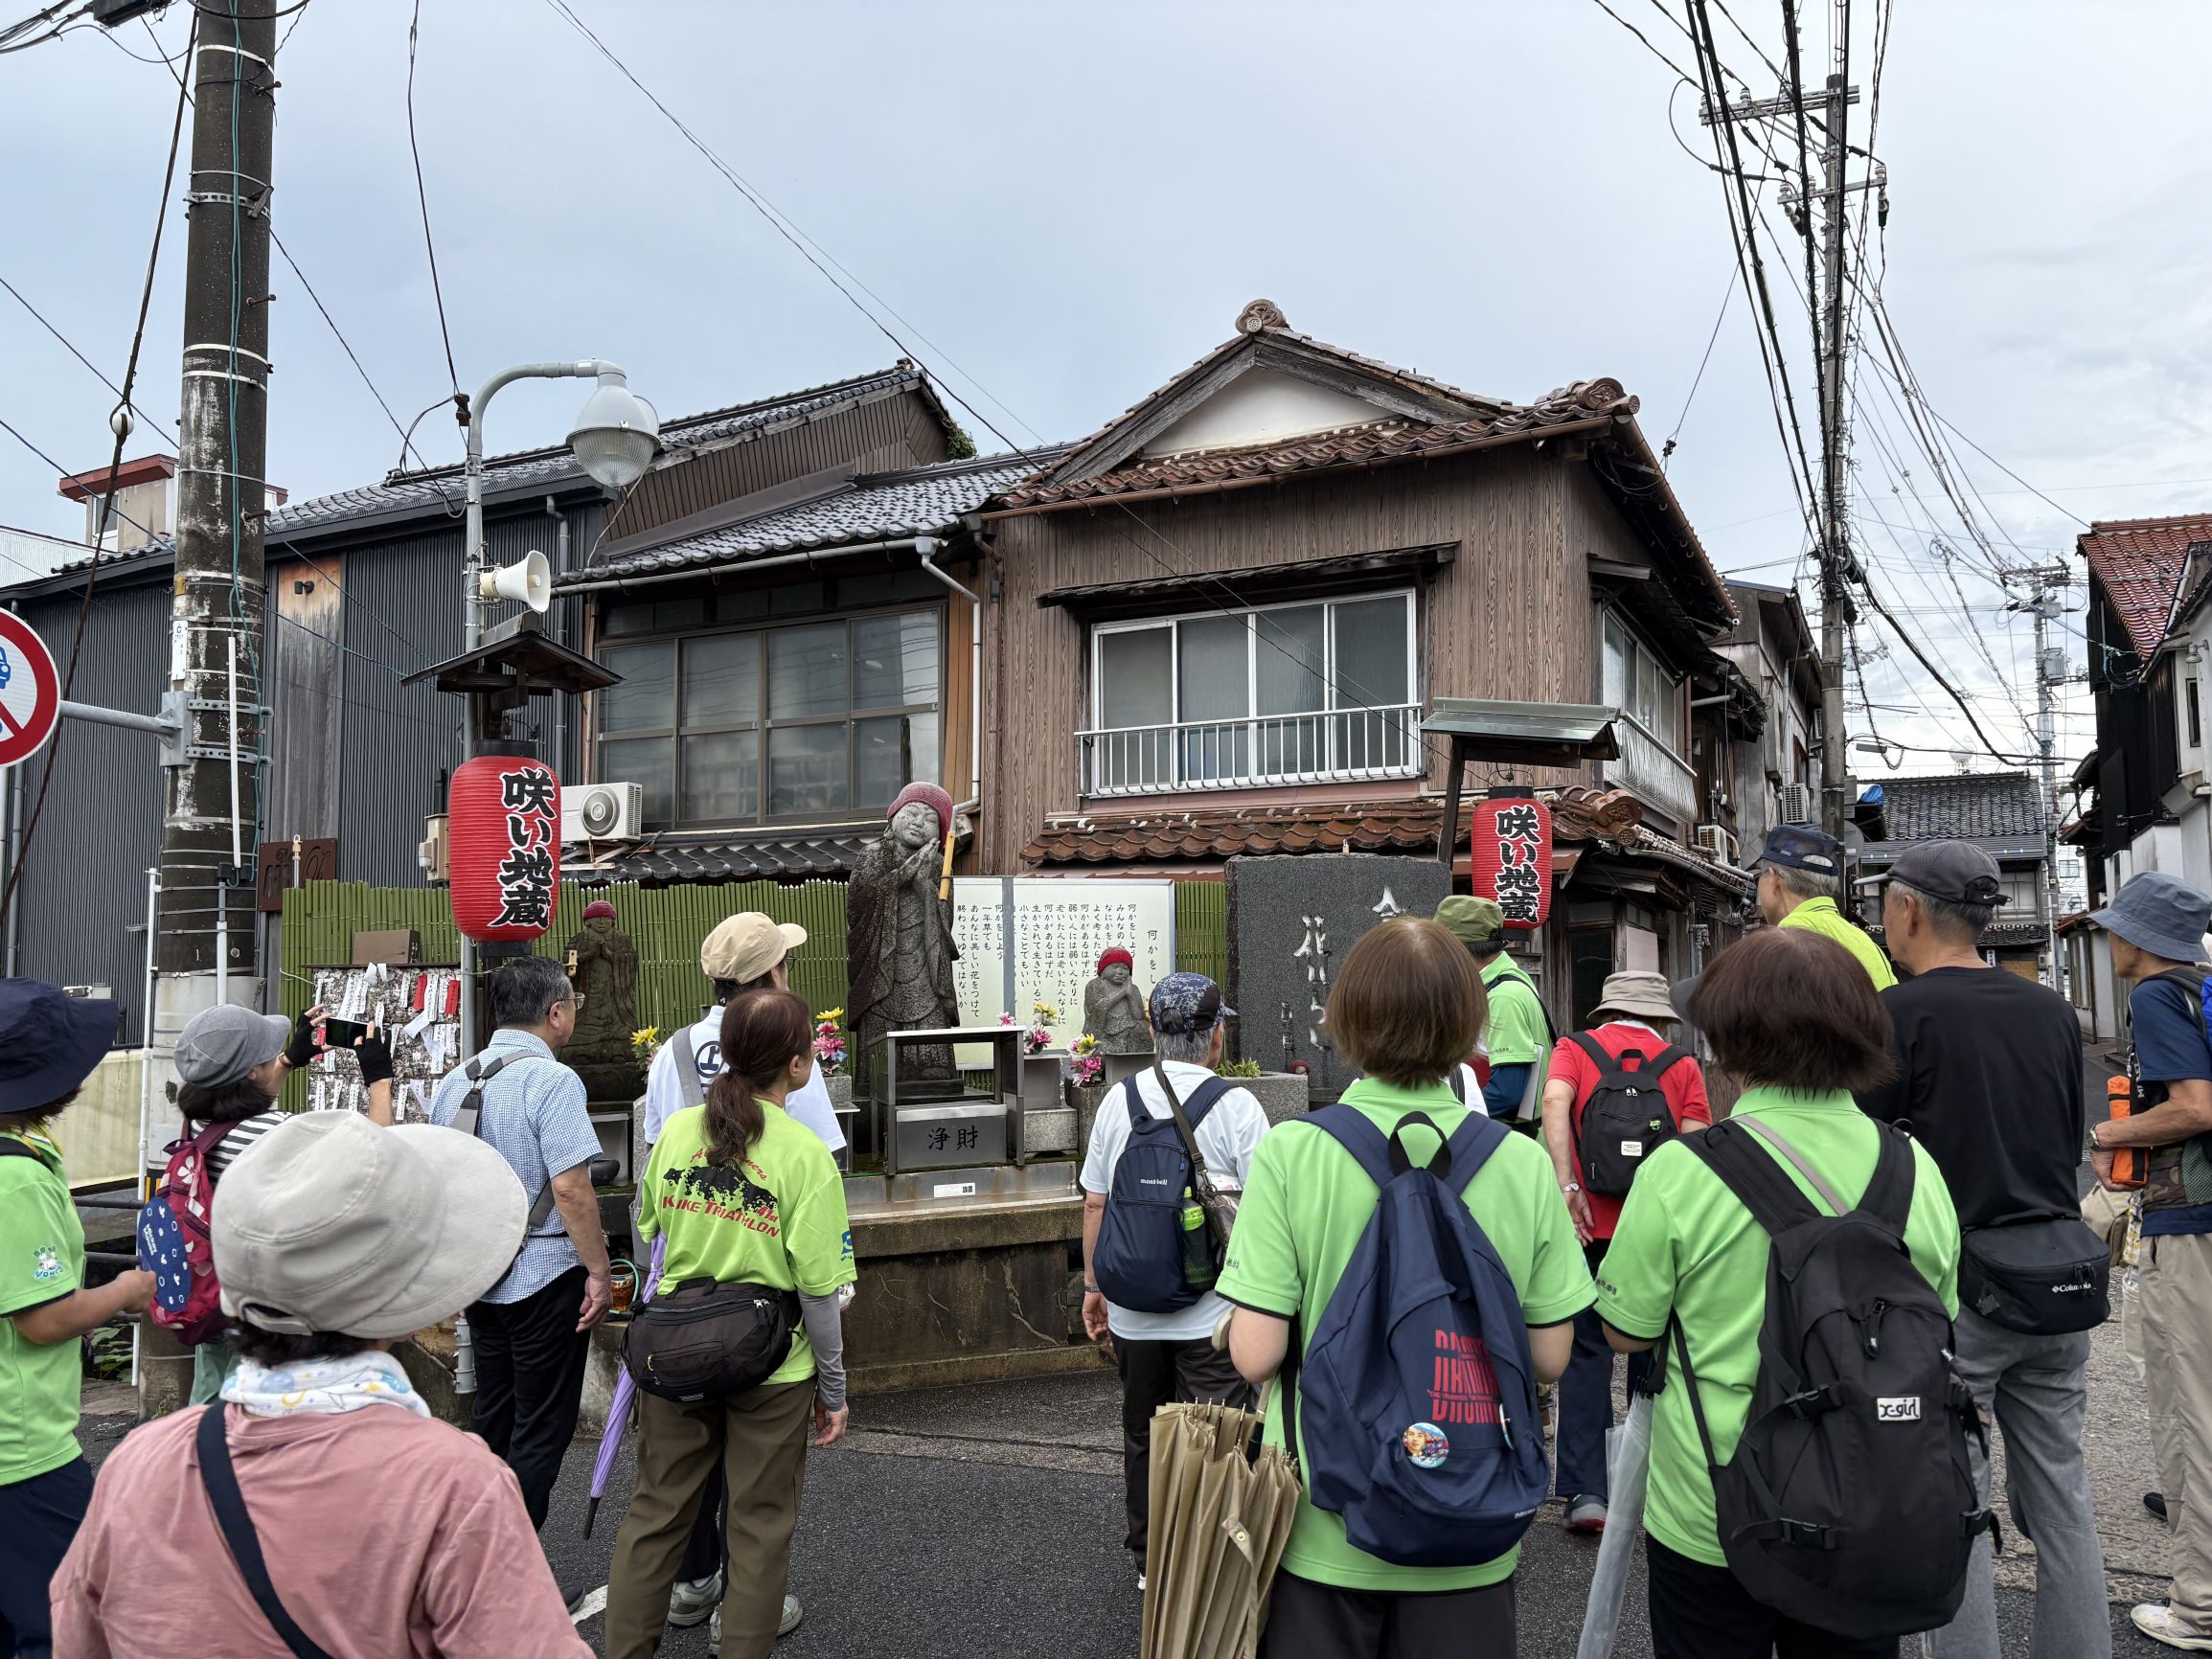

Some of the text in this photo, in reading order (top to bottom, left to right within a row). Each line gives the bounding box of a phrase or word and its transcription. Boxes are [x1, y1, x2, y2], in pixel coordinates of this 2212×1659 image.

[487, 766, 558, 929] 咲い地蔵
[1494, 805, 1543, 923] 咲い地蔵
[957, 904, 967, 1009] 終わってゆくではないか
[969, 904, 979, 1017] あんなに美しい花をつけて
[982, 906, 992, 950] 一年草でも
[1019, 904, 1029, 988] 小さなことでもいい
[1044, 904, 1054, 978] 何かがあるはずだ
[1056, 904, 1066, 1025] 老いた人には老いた人なりに
[1068, 904, 1079, 1006] 弱い人には弱い人なりに
[1081, 904, 1090, 978] 何かがあるはずだ
[1105, 904, 1113, 948] なにかをし
[1116, 904, 1125, 949] みんなの人
[1148, 930, 1157, 985] 何かをし
[927, 1125, 978, 1150] 浄財
